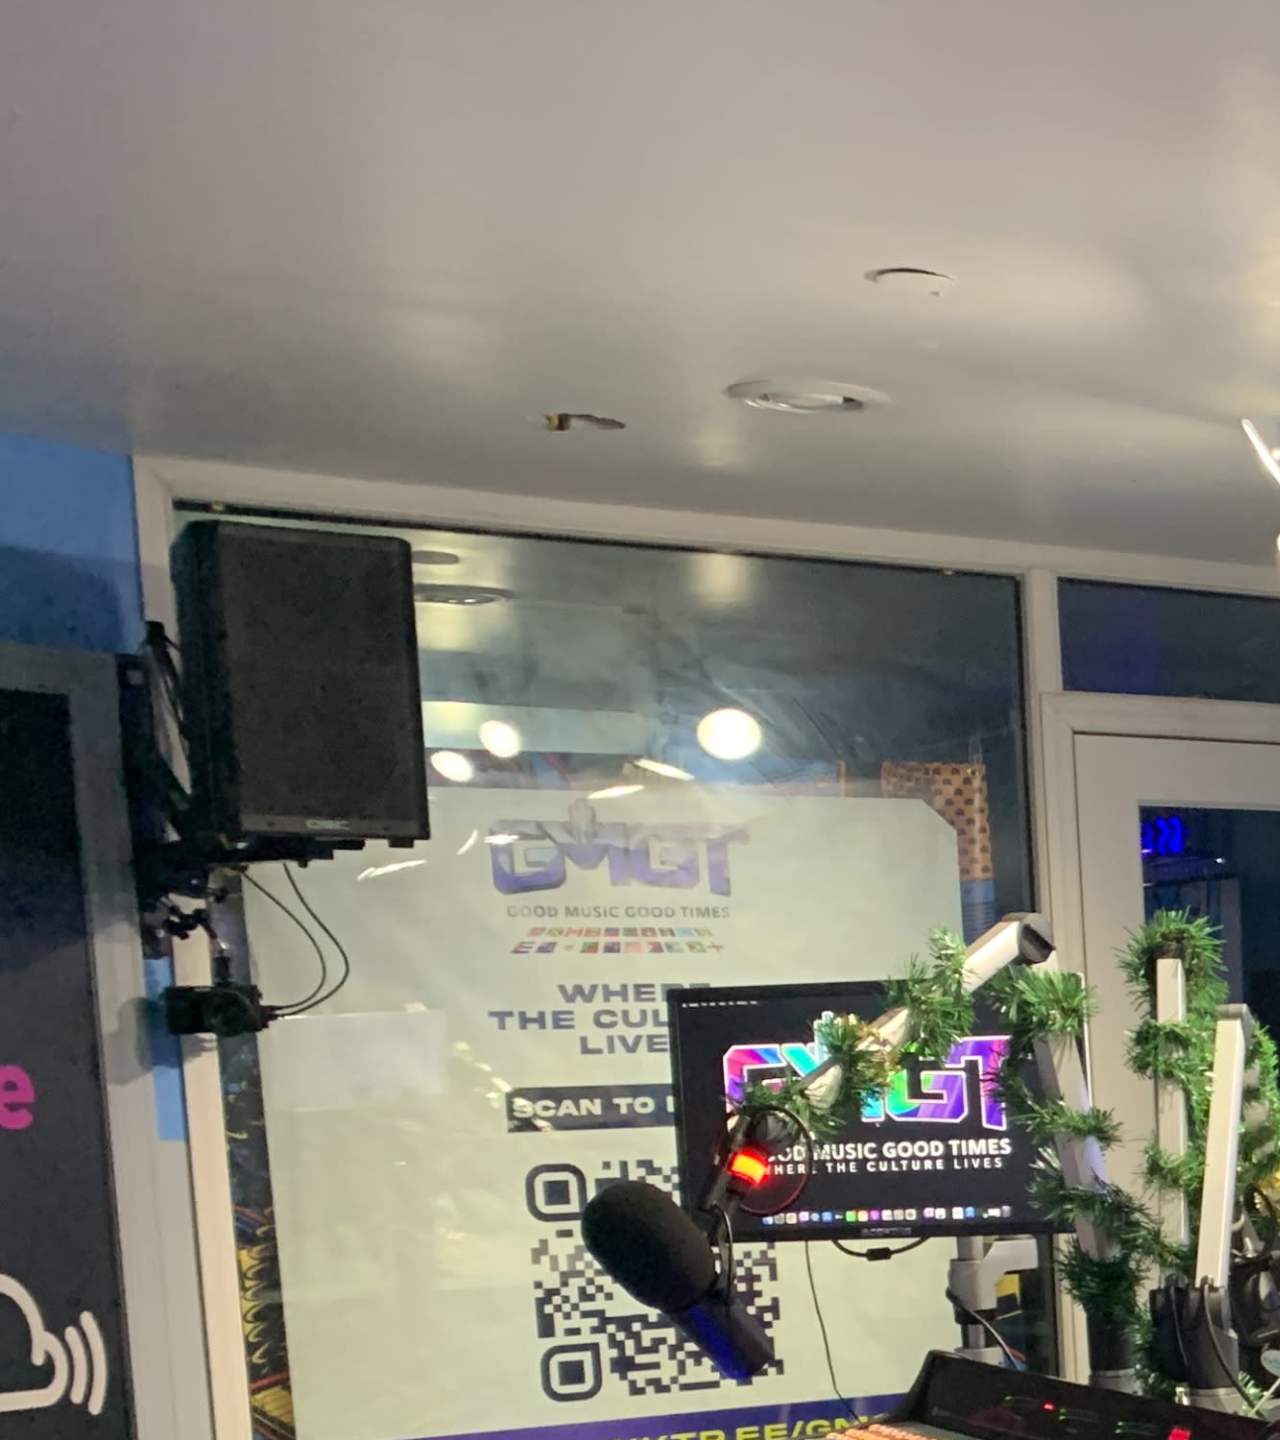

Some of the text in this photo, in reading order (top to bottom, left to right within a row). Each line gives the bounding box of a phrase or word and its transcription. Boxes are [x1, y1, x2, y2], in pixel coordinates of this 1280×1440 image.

[488, 798, 750, 897] GMGT
[506, 905, 731, 919] GOOD MUSIC GOOD TIMES
[557, 982, 711, 1004] WHE
[487, 1010, 576, 1030] THE
[579, 1034, 669, 1055] LIVE
[511, 1096, 602, 1119] SCAN
[613, 1096, 656, 1115] TO
[813, 1141, 878, 1161] MUSIC
[882, 1140, 944, 1158] GOOD
[948, 1138, 1012, 1156] TIMES
[826, 1161, 858, 1173] THE
[866, 1158, 944, 1172] CULTURE
[953, 1157, 1003, 1170] LIVES
